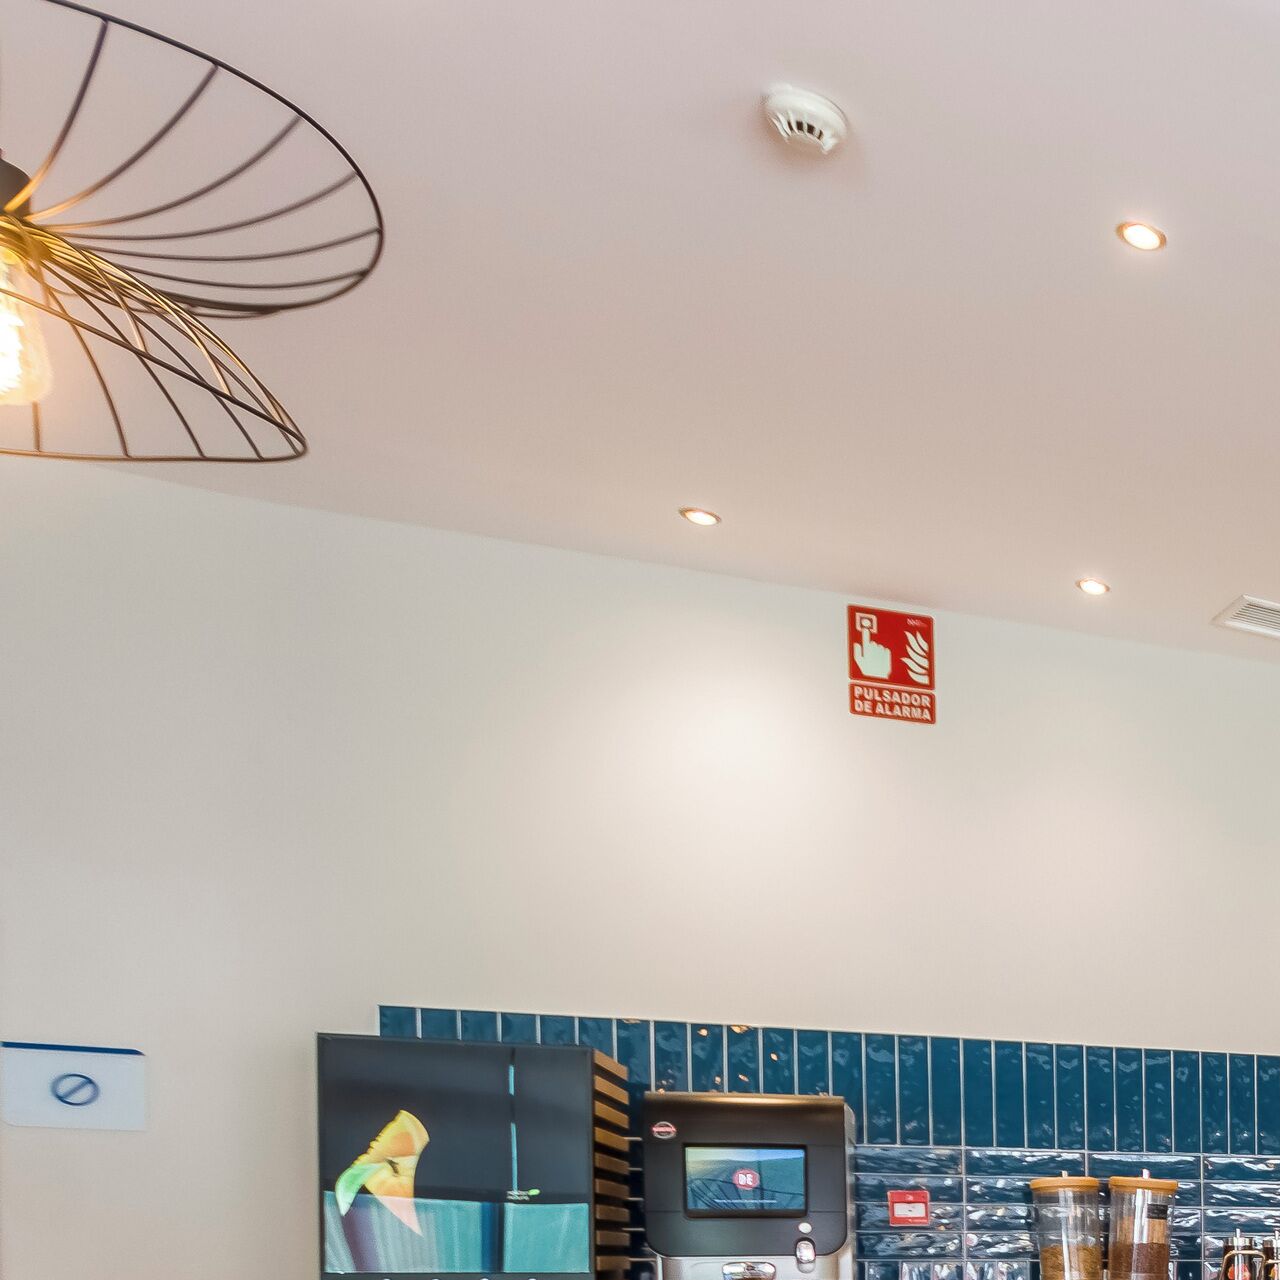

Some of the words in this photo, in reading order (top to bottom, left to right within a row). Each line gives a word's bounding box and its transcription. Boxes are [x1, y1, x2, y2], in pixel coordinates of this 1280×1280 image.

[854, 685, 931, 708] PULSADOR
[854, 699, 874, 714] DE
[875, 702, 932, 721] ALARMA
